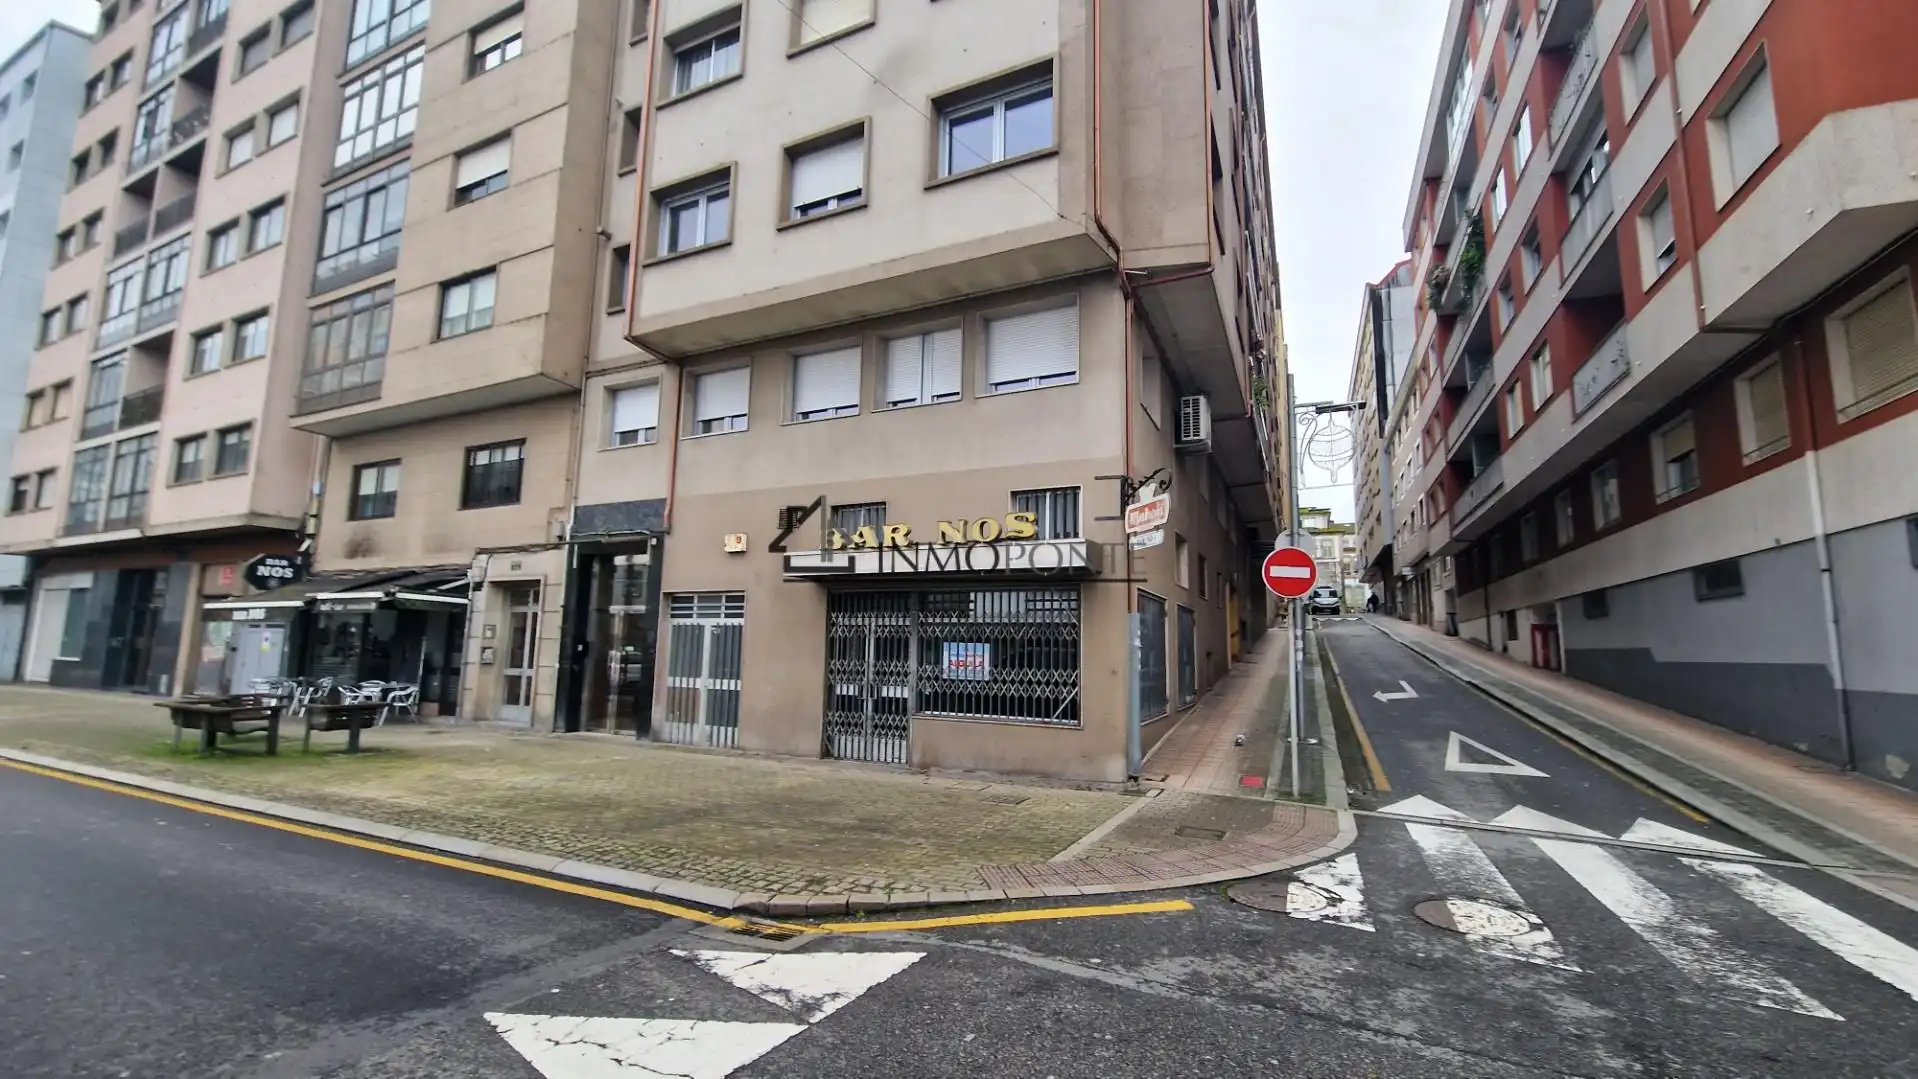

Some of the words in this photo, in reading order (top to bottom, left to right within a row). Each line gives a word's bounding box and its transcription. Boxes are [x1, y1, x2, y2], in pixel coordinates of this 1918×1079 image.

[936, 511, 1037, 546] NOS
[265, 558, 289, 566] BAR
[256, 565, 294, 578] NOS
